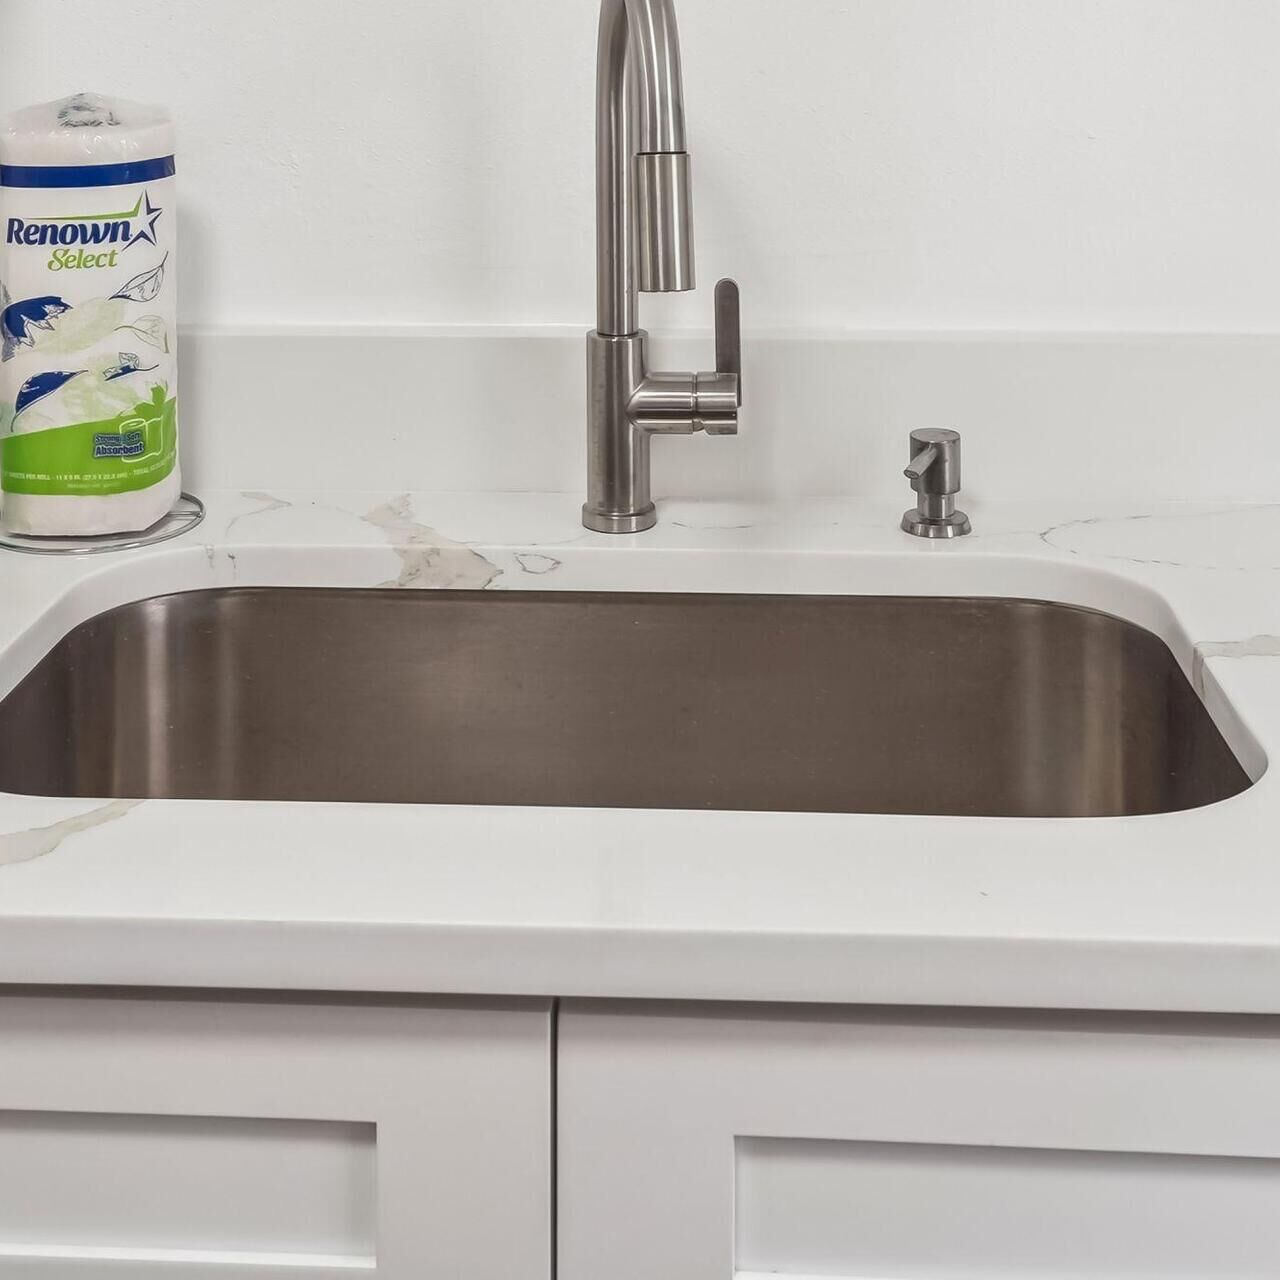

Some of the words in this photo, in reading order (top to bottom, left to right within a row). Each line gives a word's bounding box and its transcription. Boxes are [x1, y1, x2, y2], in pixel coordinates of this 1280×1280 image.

[6, 217, 131, 246] Renown
[47, 248, 119, 271] Select
[96, 442, 144, 456] Absorbent
